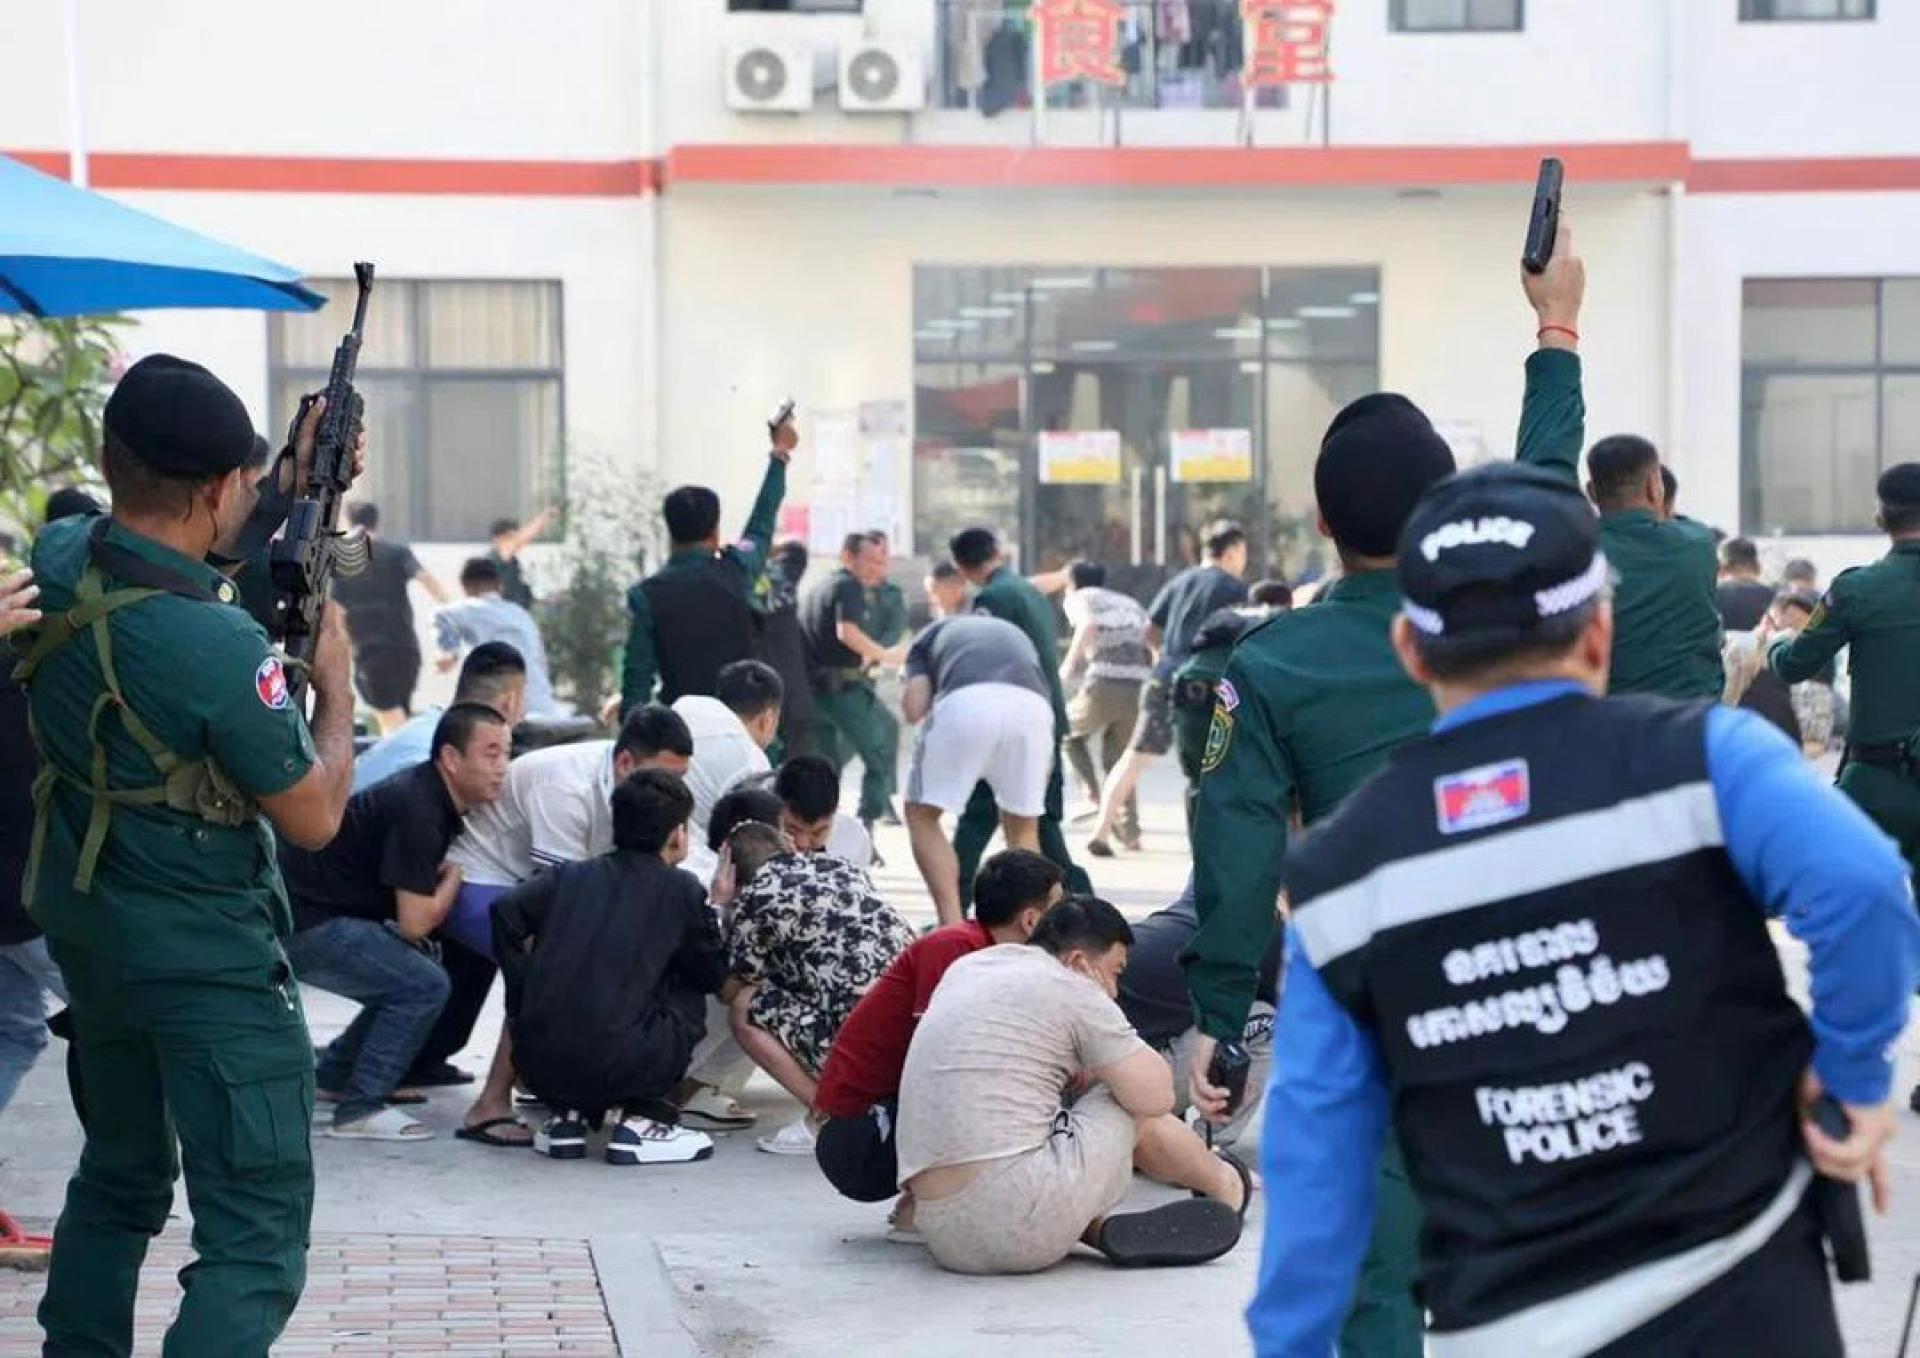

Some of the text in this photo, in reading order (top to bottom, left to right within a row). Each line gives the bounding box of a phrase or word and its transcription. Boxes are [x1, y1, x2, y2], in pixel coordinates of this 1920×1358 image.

[1420, 516, 1536, 561] POLICE
[1475, 1061, 1654, 1125] FORENSIC
[1504, 1103, 1643, 1164] POLICE
